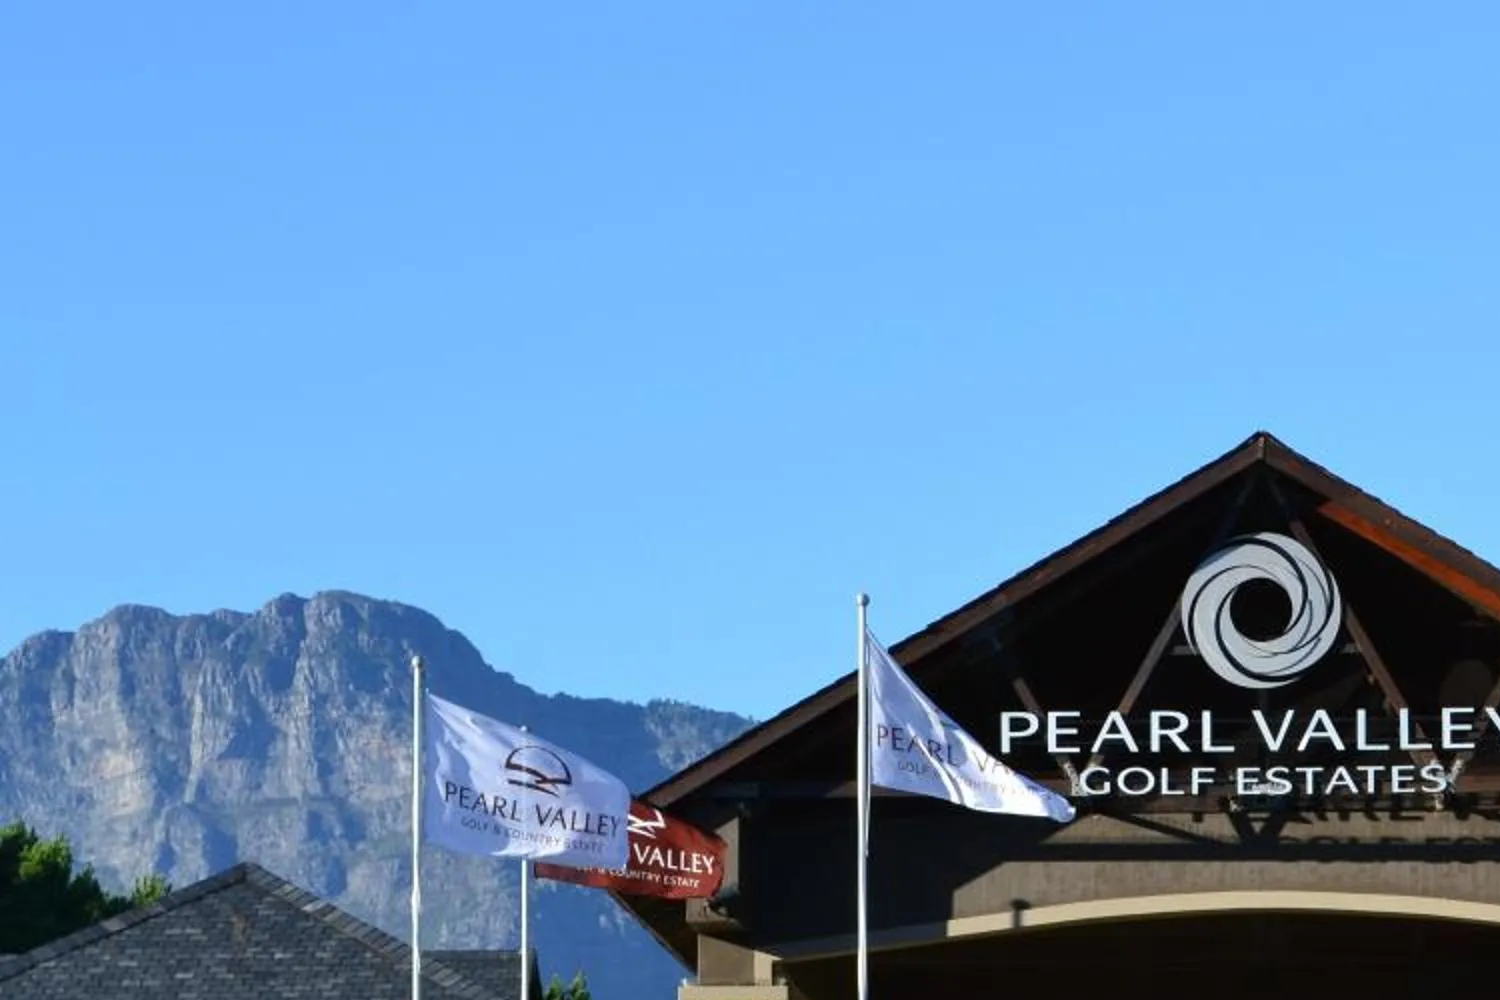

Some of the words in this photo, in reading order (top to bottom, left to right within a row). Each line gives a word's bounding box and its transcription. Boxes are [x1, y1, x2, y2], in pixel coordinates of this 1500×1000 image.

[876, 723, 964, 767] PEARL
[1000, 709, 1236, 754] PEARL
[1079, 767, 1217, 796] GOLF
[1236, 765, 1448, 796] ESTATES
[444, 781, 521, 822] PEARL
[534, 803, 621, 838] VALLEY
[632, 842, 715, 875] VALLEY
[663, 874, 701, 889] ESTATE
